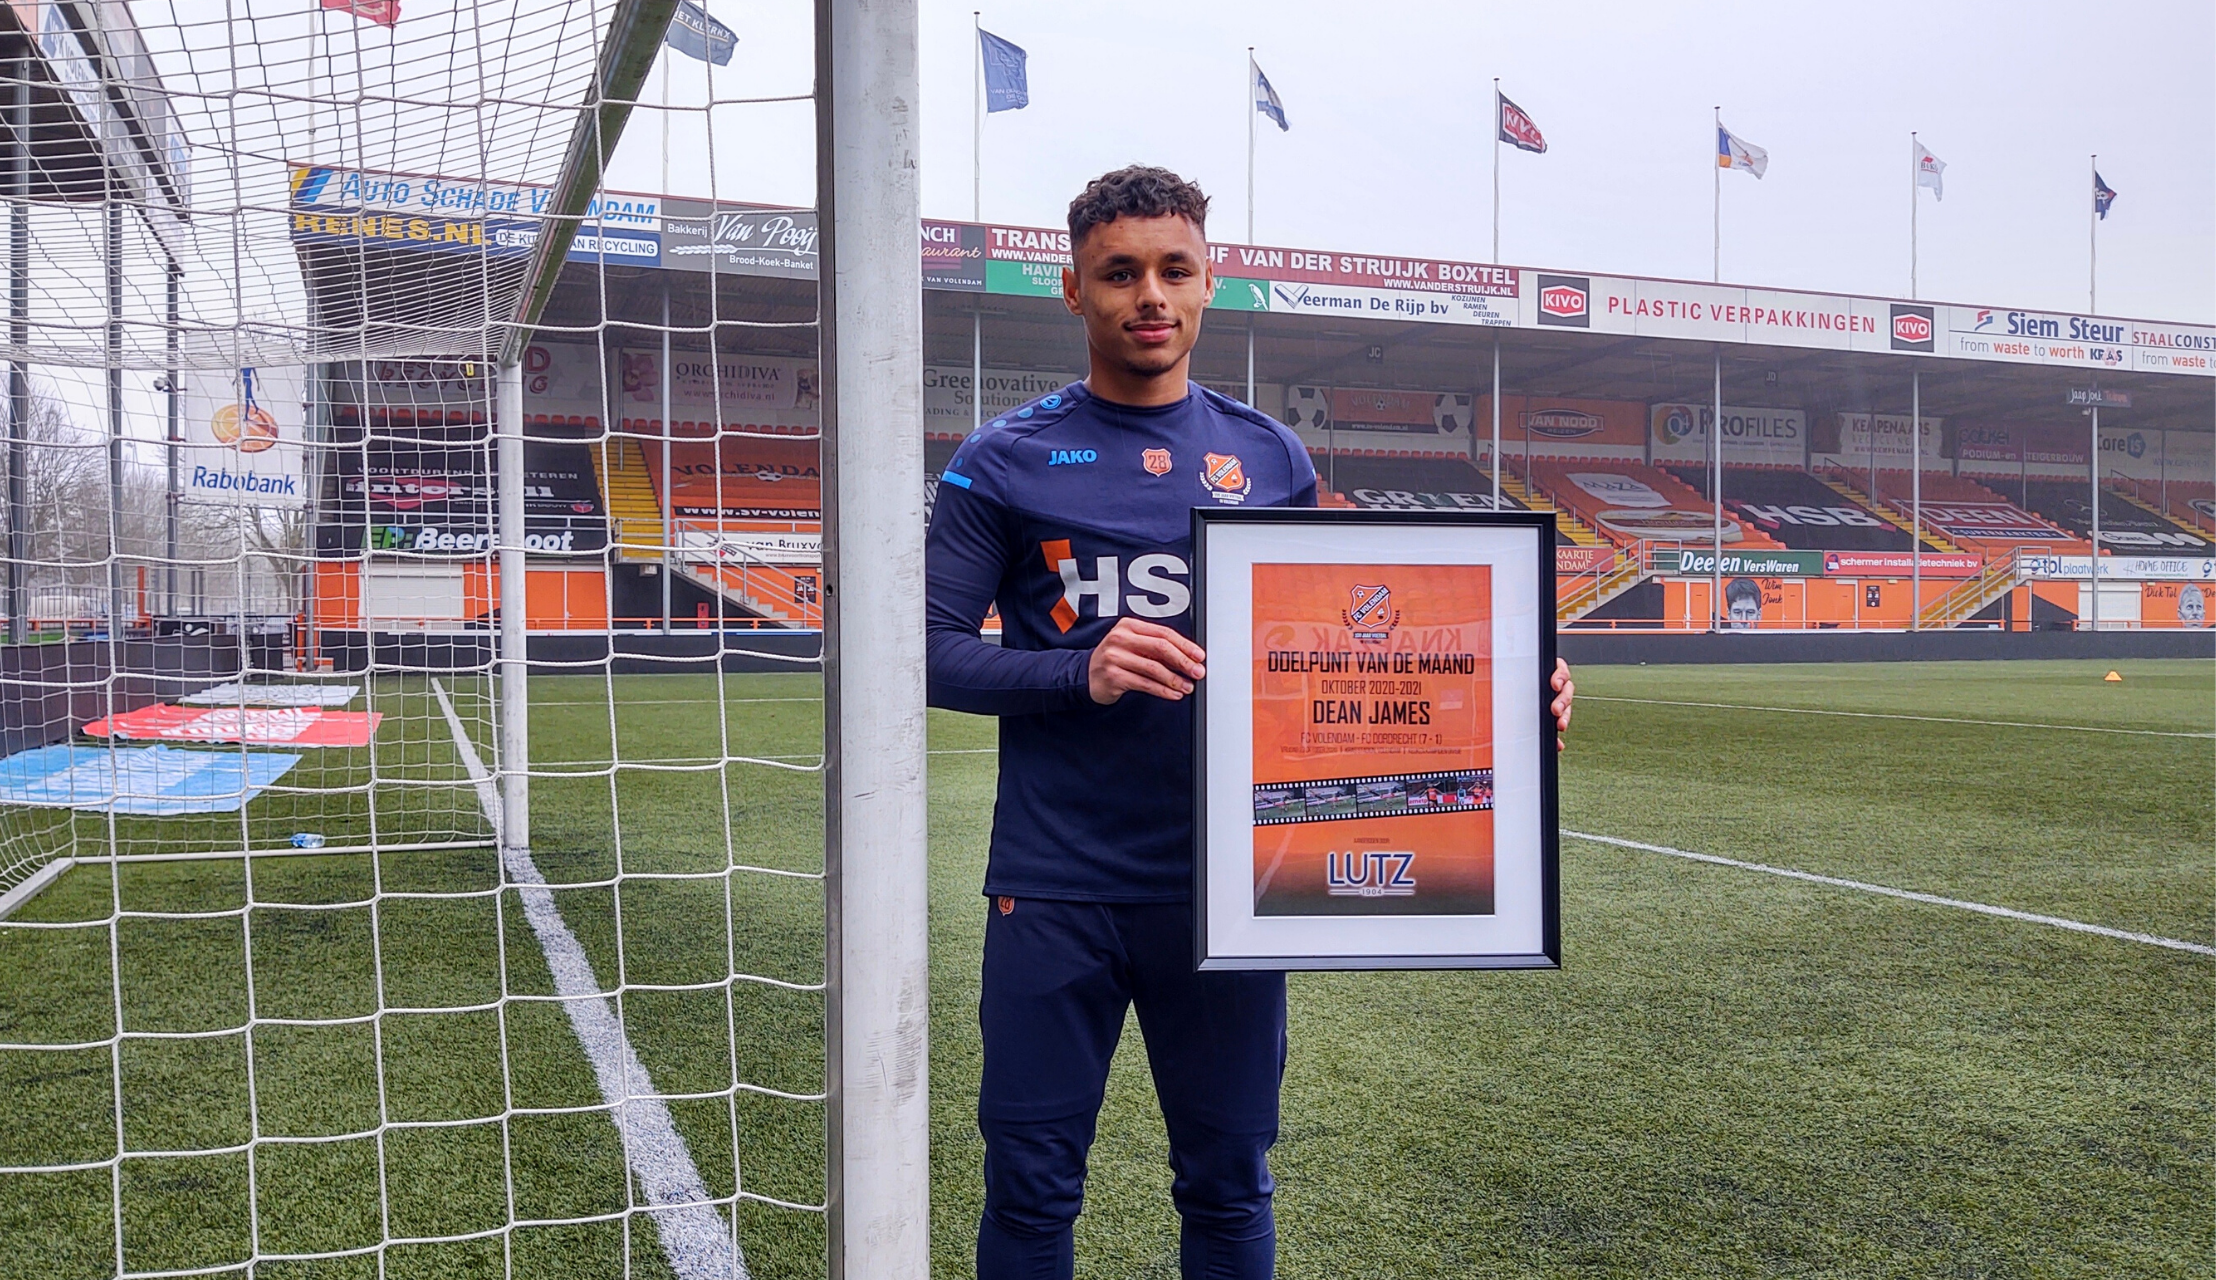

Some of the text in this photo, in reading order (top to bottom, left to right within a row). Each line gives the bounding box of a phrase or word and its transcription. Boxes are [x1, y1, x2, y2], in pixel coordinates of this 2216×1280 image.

[295, 213, 493, 247] RENES.NL
[667, 223, 708, 239] Bakkerij
[712, 213, 754, 242] Van
[588, 238, 656, 255] RECYCLING
[729, 254, 814, 270] Brood-Koek-Banket
[1239, 248, 1284, 268] VAN
[1290, 252, 1333, 273] DER
[1339, 256, 1430, 280] STRUIJK
[1437, 263, 1516, 286] BOXTEL
[943, 277, 983, 286] VOLENDAM
[1382, 278, 1514, 297] WWW.VANDERSTRUIJK.NL
[1369, 297, 1390, 312] De
[1394, 299, 1425, 316] Rijp
[1430, 300, 1449, 316] bv
[1450, 294, 1487, 304] KOZIJNEN
[1463, 302, 1488, 311] RAMEN
[1544, 293, 1582, 310] KIVO
[1472, 310, 1500, 319] DEUREN
[1480, 317, 1512, 327] TRAPPEN
[1608, 296, 1876, 334] PLASTIC VERPAKKINGEN
[1896, 320, 1929, 336] KIVO
[2007, 311, 2125, 343] Siem Steur
[1960, 336, 1989, 353] from
[1993, 341, 2030, 356] waste
[2034, 342, 2046, 358] to
[2049, 345, 2085, 360] worth
[2142, 350, 2169, 366] from
[2172, 355, 2206, 368] waste
[675, 362, 779, 381] ORCHIDIVA
[1558, 416, 1598, 428] NOOD
[1048, 449, 1098, 466] JAKO
[1148, 454, 1168, 470] 28
[192, 465, 295, 496] Rabobank
[1740, 504, 1883, 527] HSB
[1918, 507, 2033, 525] DEEN
[414, 527, 574, 551] Beereoot
[1681, 551, 1800, 573] Deeen VersWaren
[1840, 557, 1883, 567] schermer
[1966, 559, 1978, 568] bv
[2063, 563, 2109, 576] plaatwrk
[2160, 560, 2188, 573] OFFICE
[1267, 651, 1475, 675] DOELPUNT VAN DE MAAND
[1321, 679, 1422, 696] OKTOBER 2020-2021
[1313, 700, 1431, 725] DEAN JAMES
[1300, 732, 1311, 744] FC
[1312, 732, 1355, 745] VOLENDAM
[1361, 732, 1372, 745] FC
[1373, 733, 1417, 745] DORDRECHT
[1328, 852, 1414, 885] LUTZ
